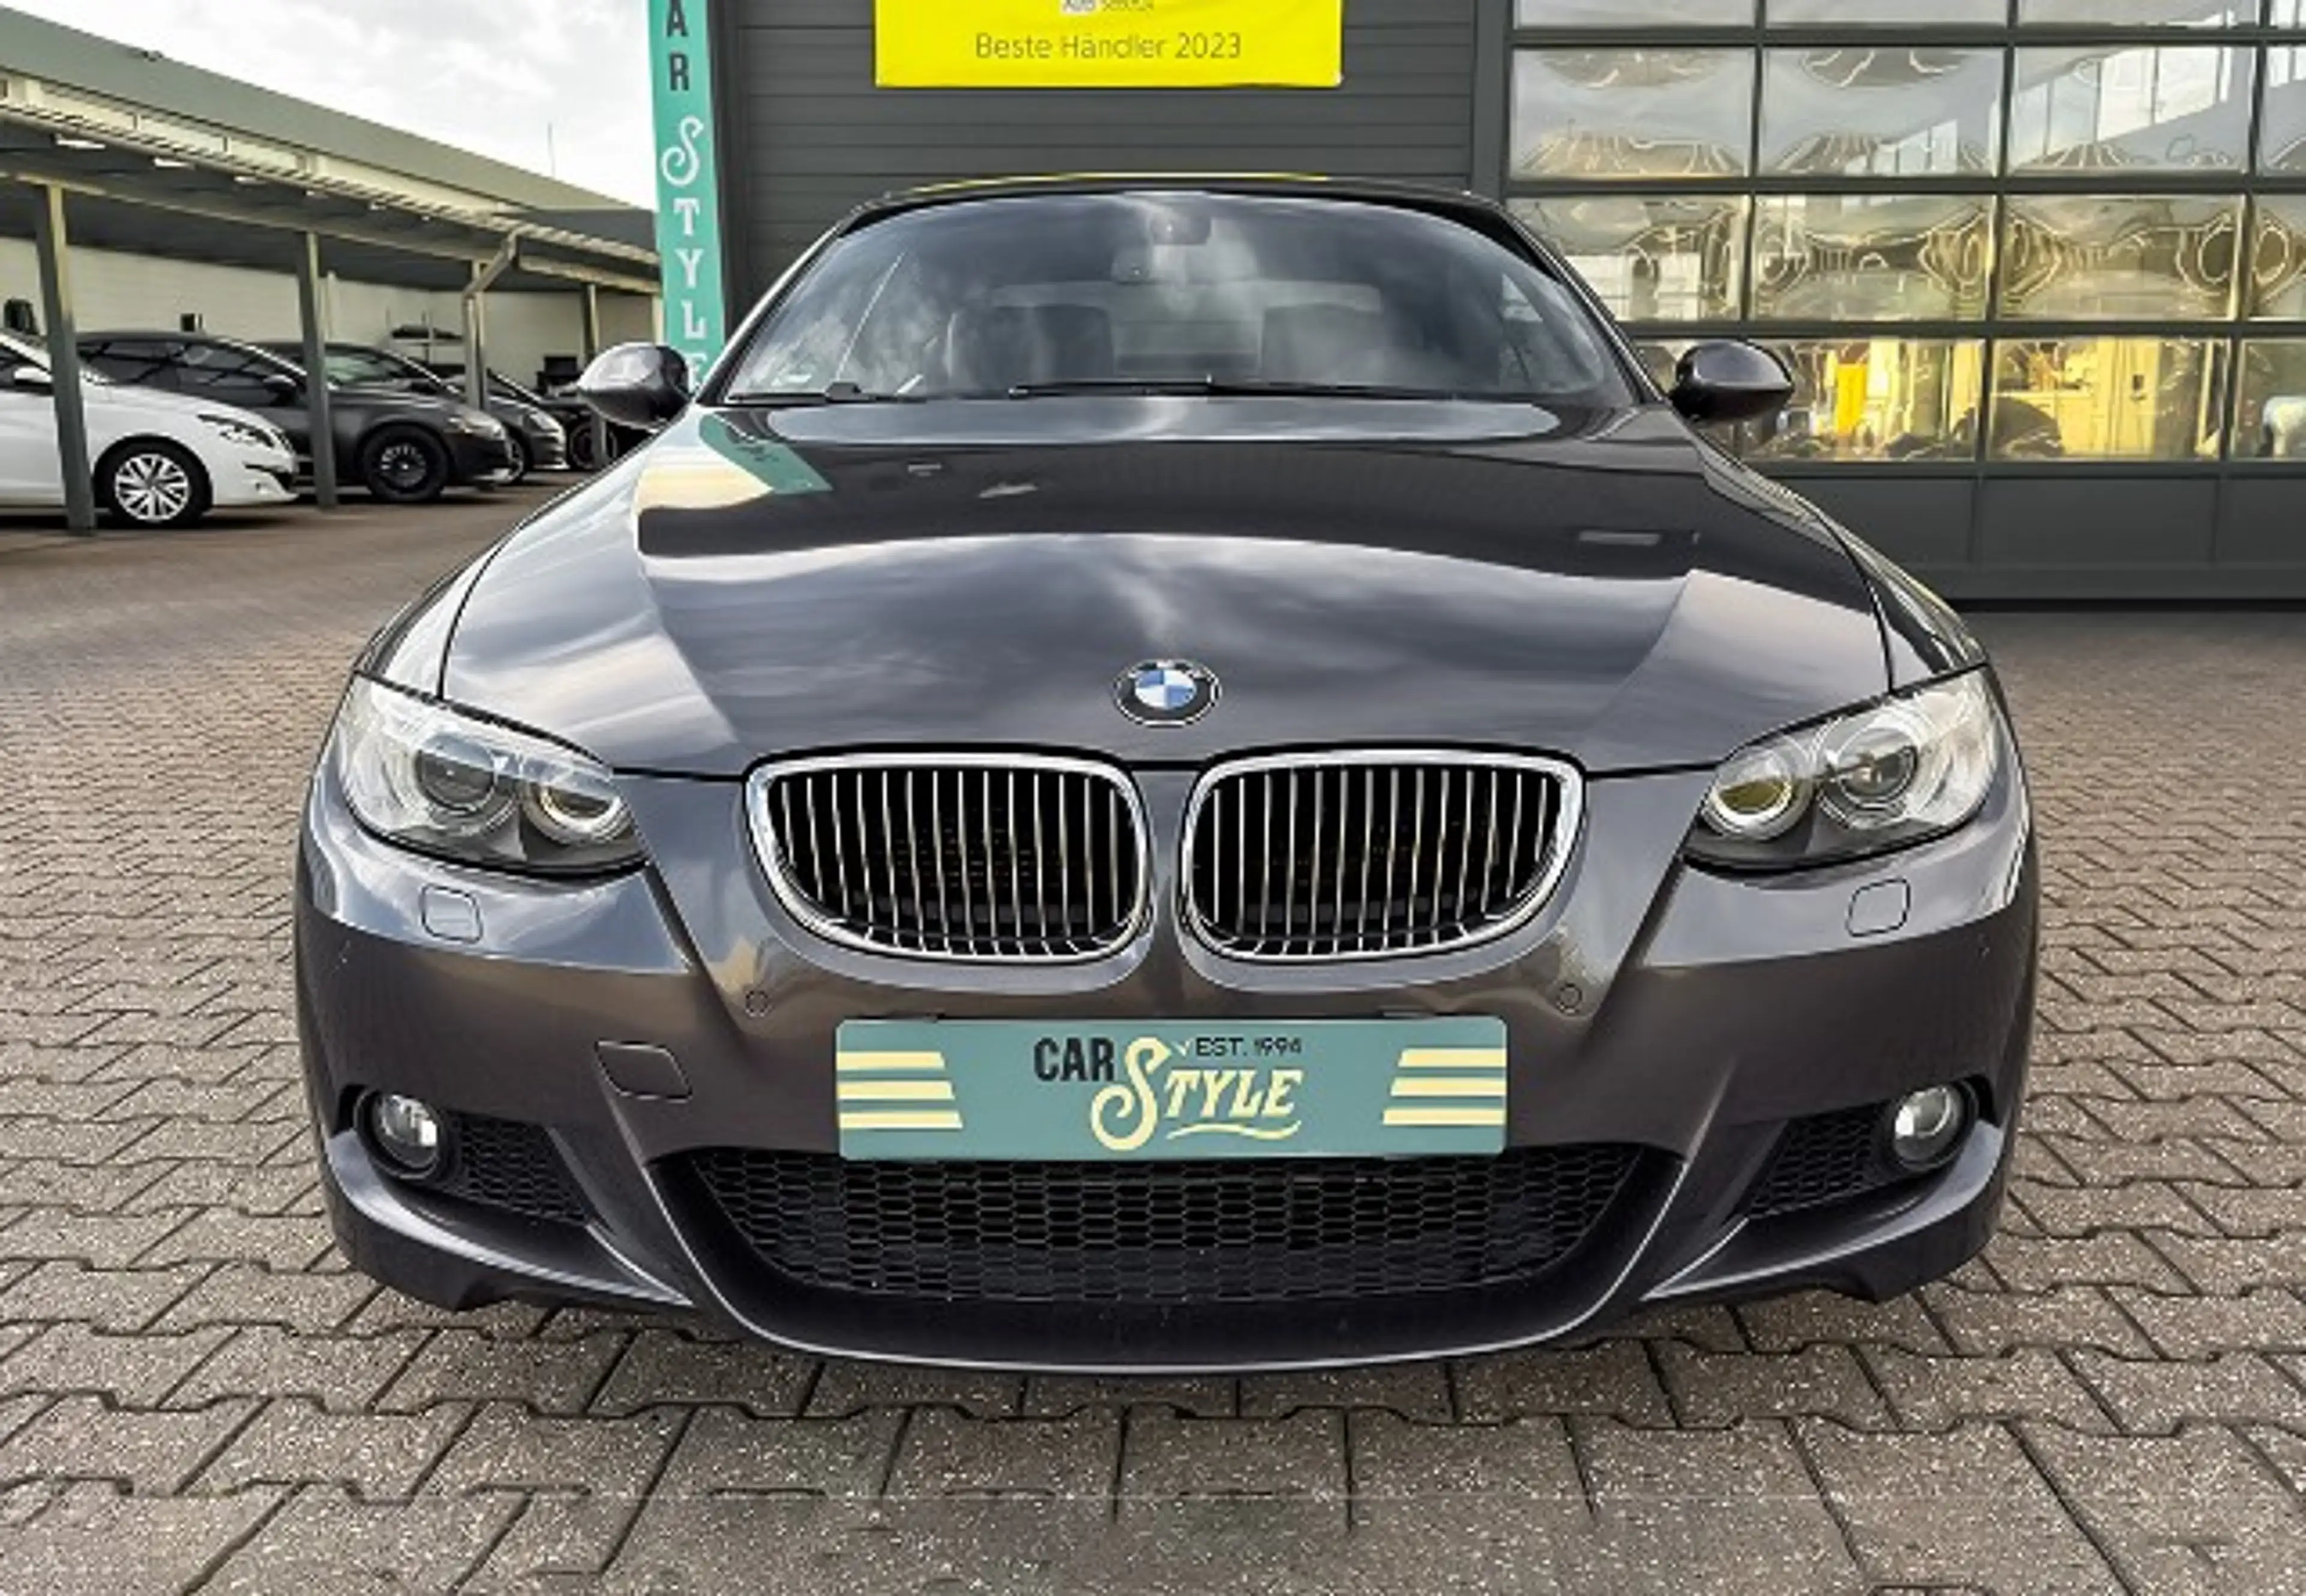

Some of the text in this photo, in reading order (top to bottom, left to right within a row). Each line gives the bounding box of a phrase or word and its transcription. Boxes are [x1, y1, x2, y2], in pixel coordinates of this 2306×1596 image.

[975, 32, 1242, 59] Beste Händler 2023
[1033, 1037, 1115, 1082] CAR
[1196, 1037, 1302, 1057] EST. 1994
[1090, 1036, 1304, 1151] STYLE
